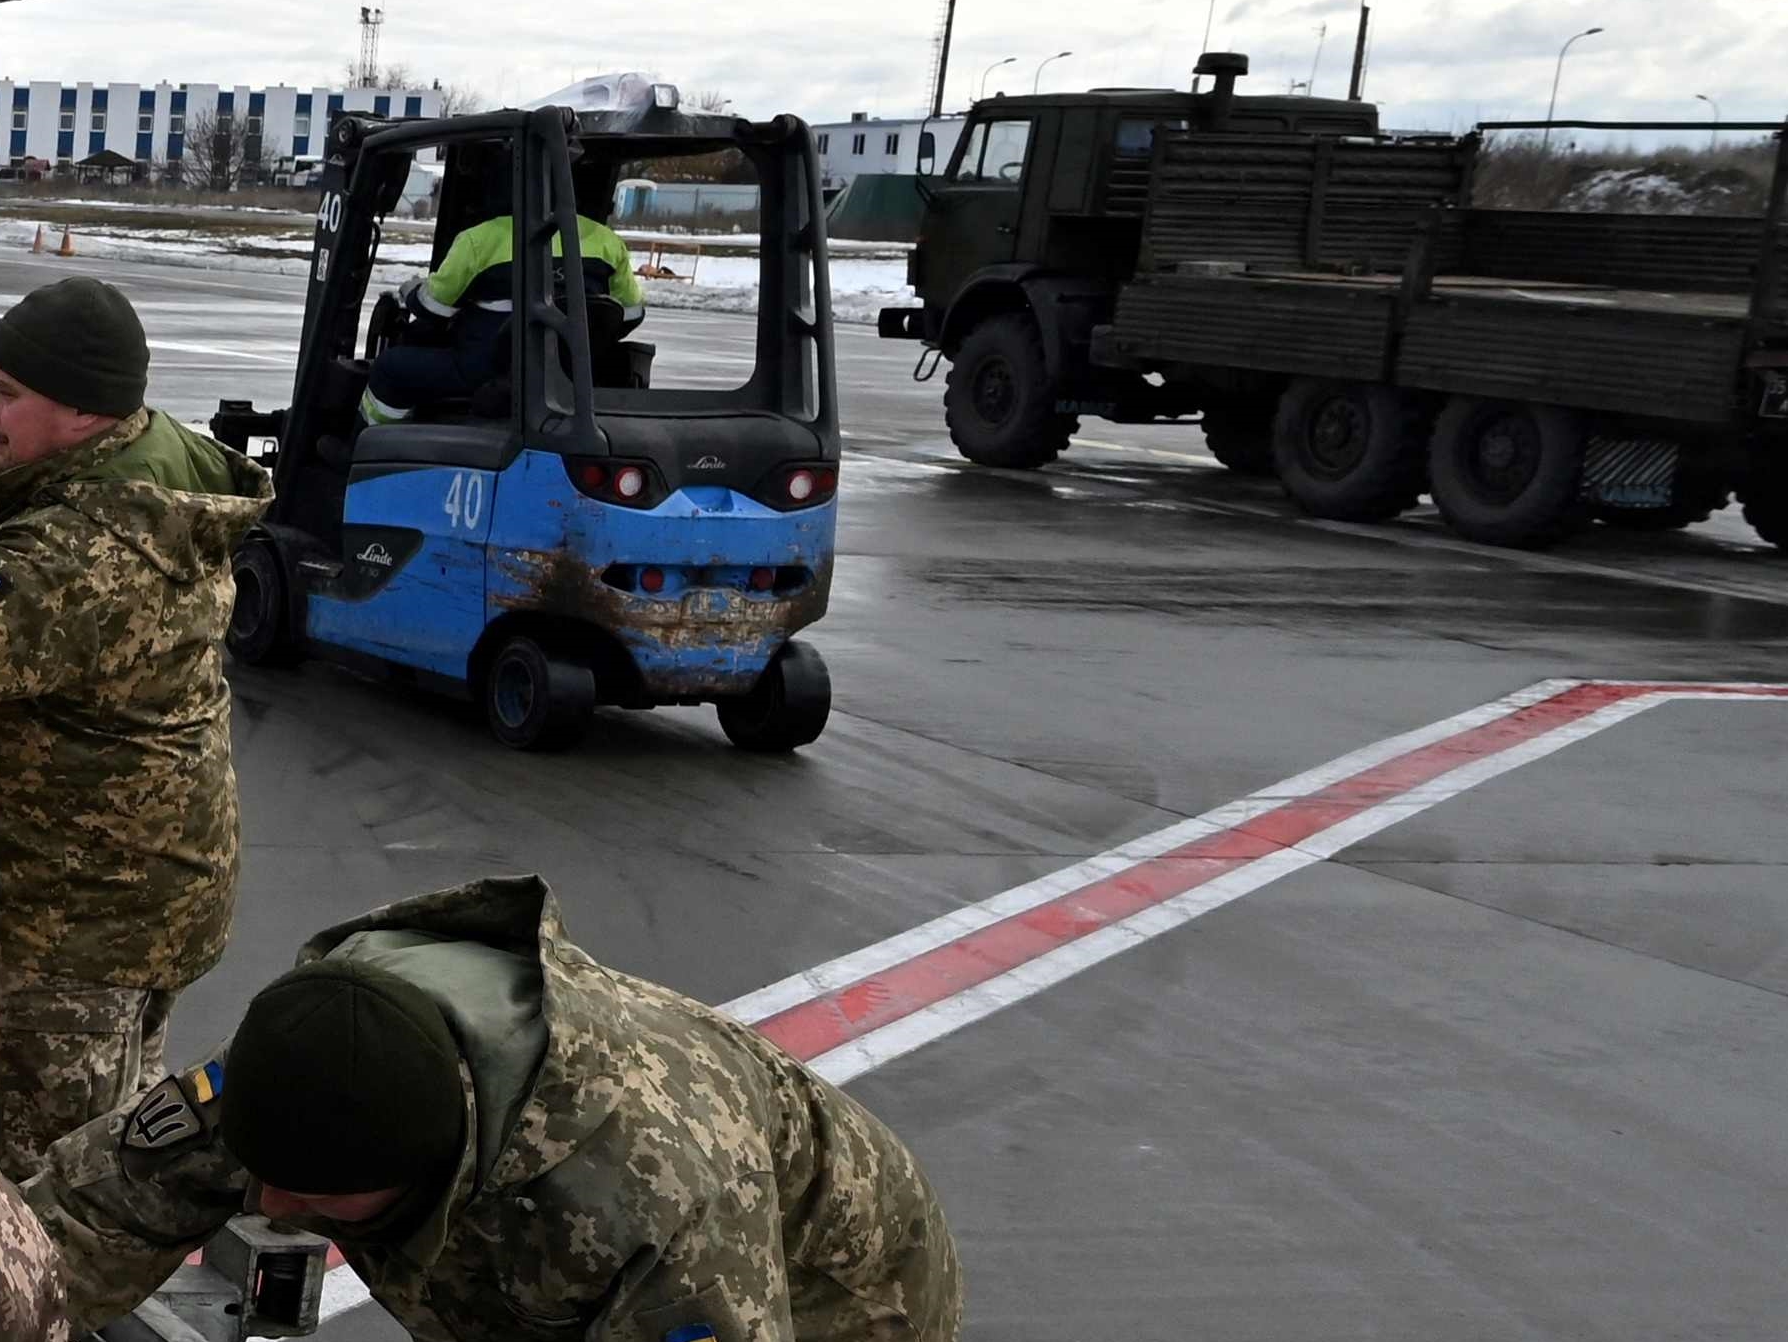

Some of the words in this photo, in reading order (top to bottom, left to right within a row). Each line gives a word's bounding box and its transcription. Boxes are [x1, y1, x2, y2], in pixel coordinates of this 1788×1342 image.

[318, 191, 341, 233] 40
[445, 471, 483, 530] 40
[356, 543, 393, 567] Linde
